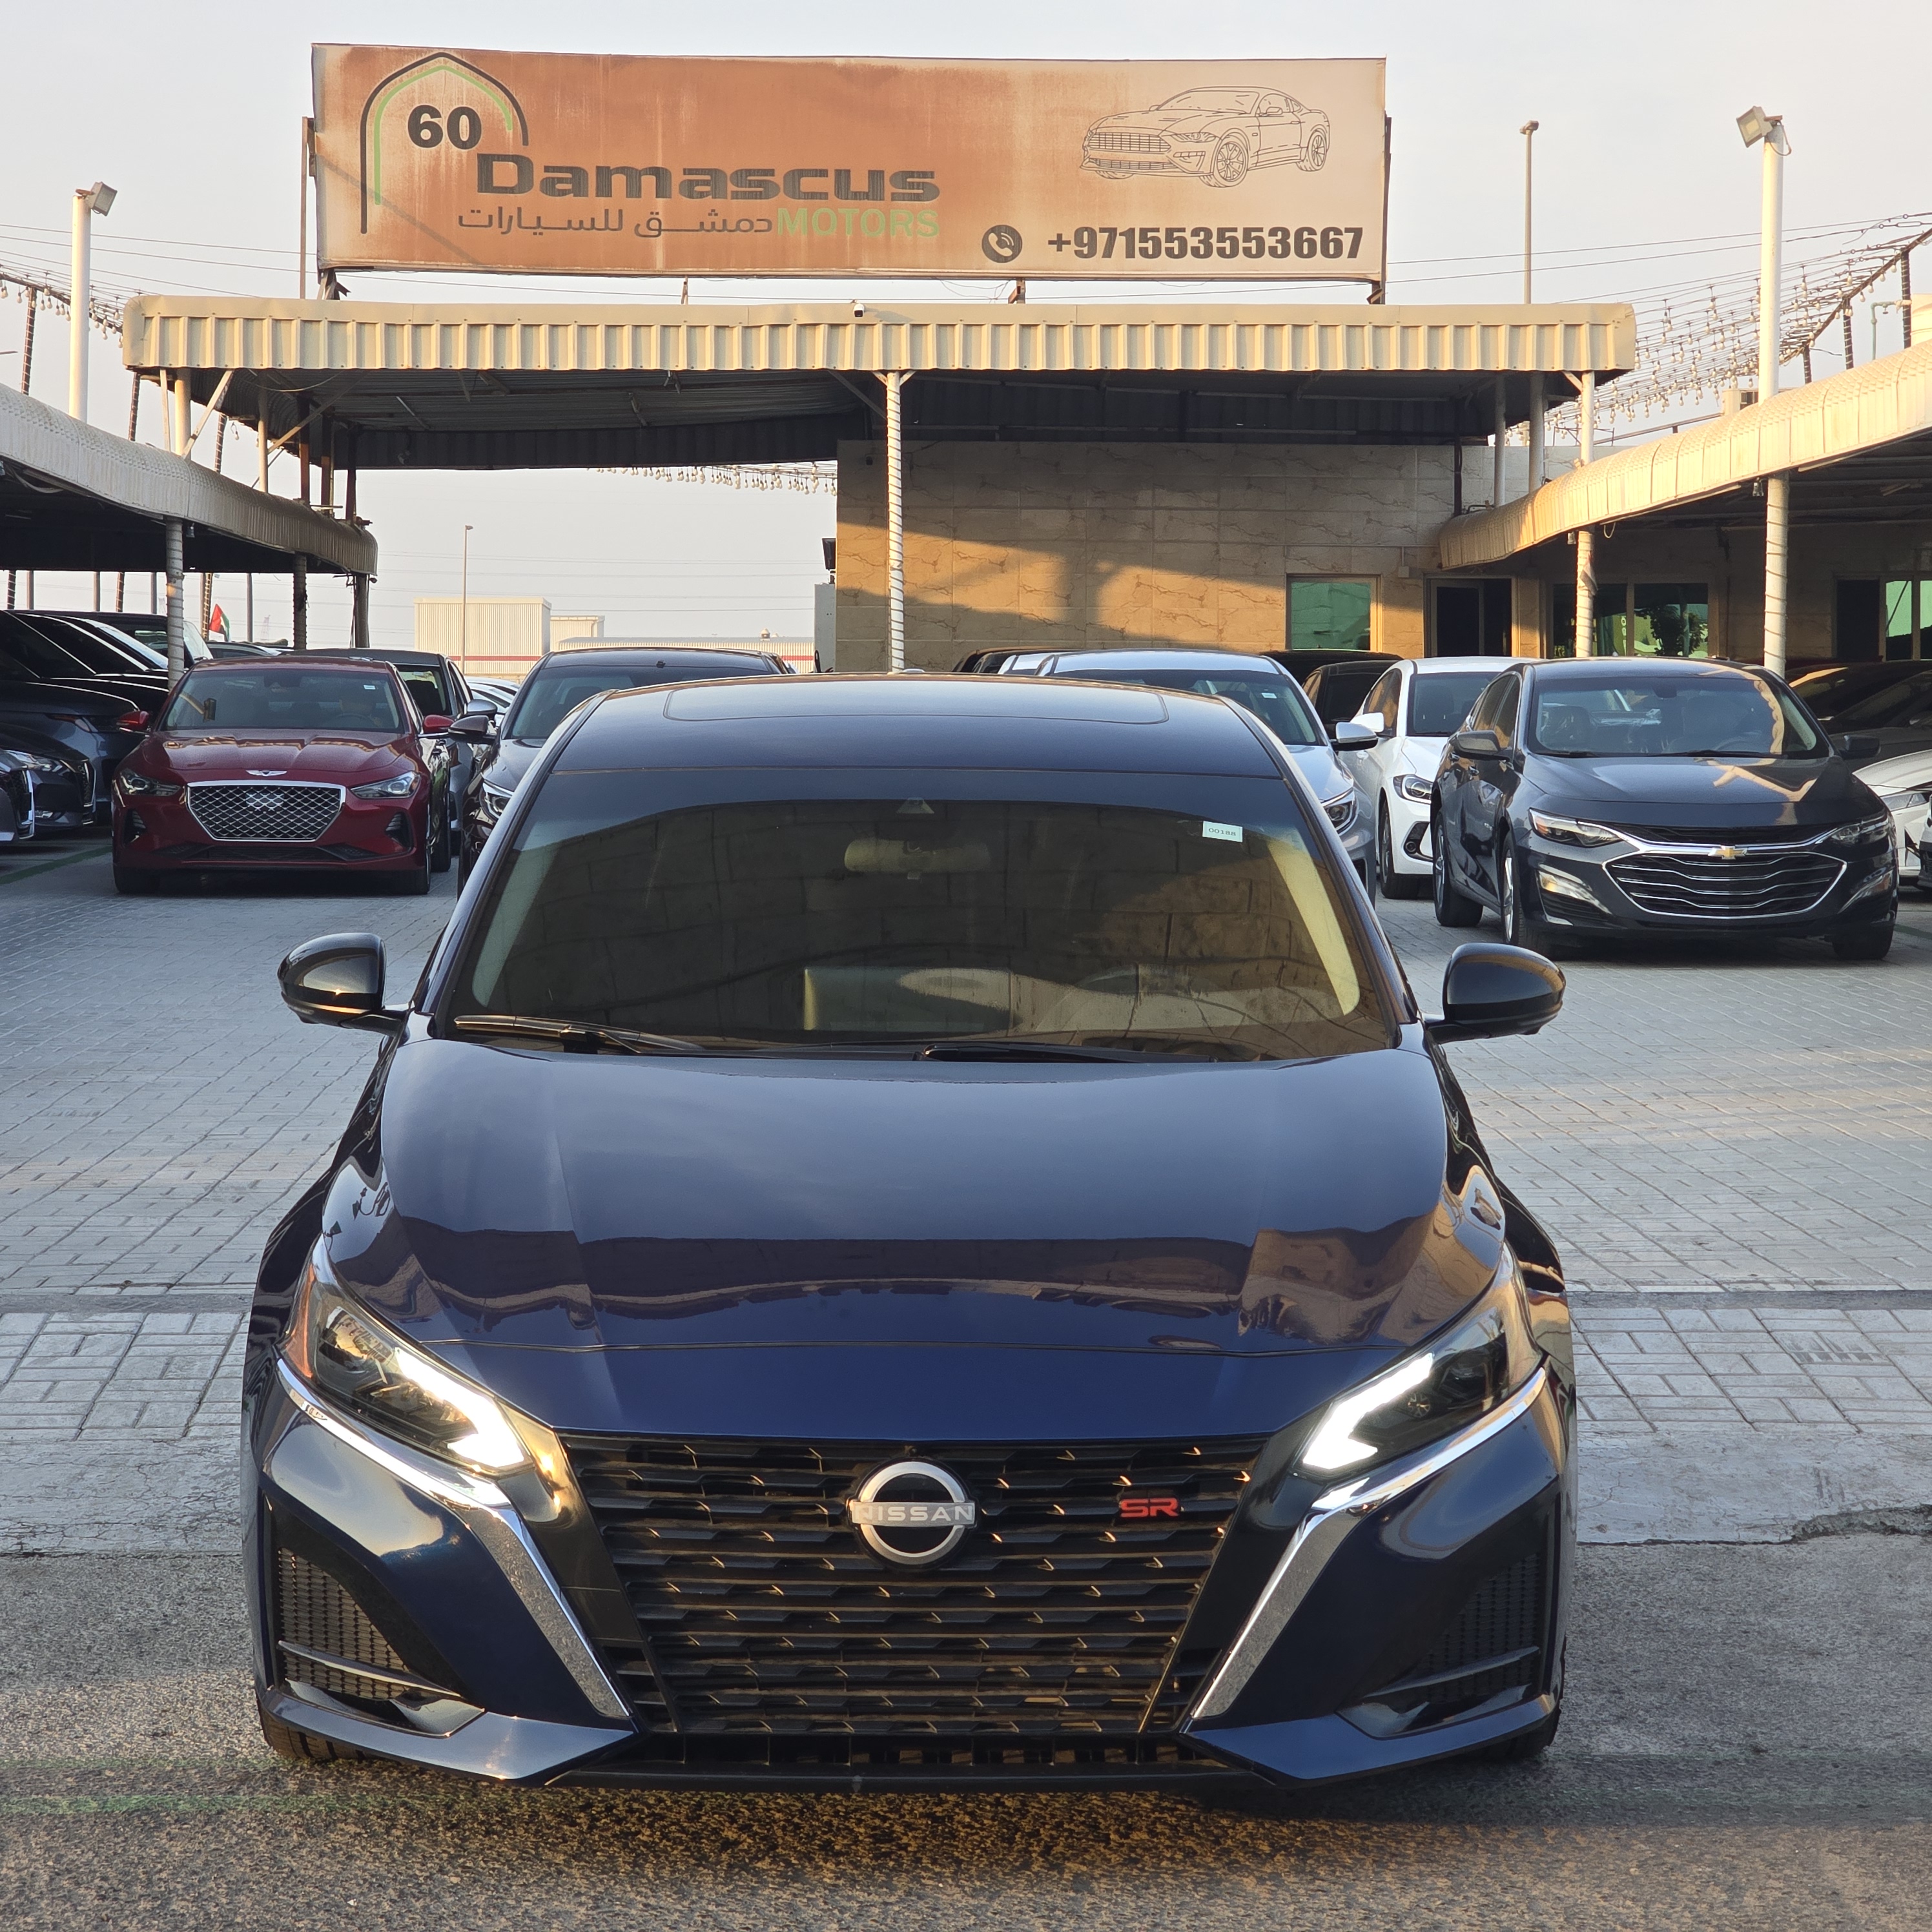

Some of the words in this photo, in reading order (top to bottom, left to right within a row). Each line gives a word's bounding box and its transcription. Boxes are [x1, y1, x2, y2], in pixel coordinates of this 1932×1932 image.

[407, 105, 482, 150] 60
[477, 152, 941, 202] Damascus
[458, 206, 624, 236] للسيارات
[634, 208, 773, 238] دمشق
[777, 206, 940, 238] MOTORS
[1048, 226, 1364, 260] +971553553667
[856, 1505, 972, 1521] NISSAN
[1120, 1497, 1178, 1517] SR
